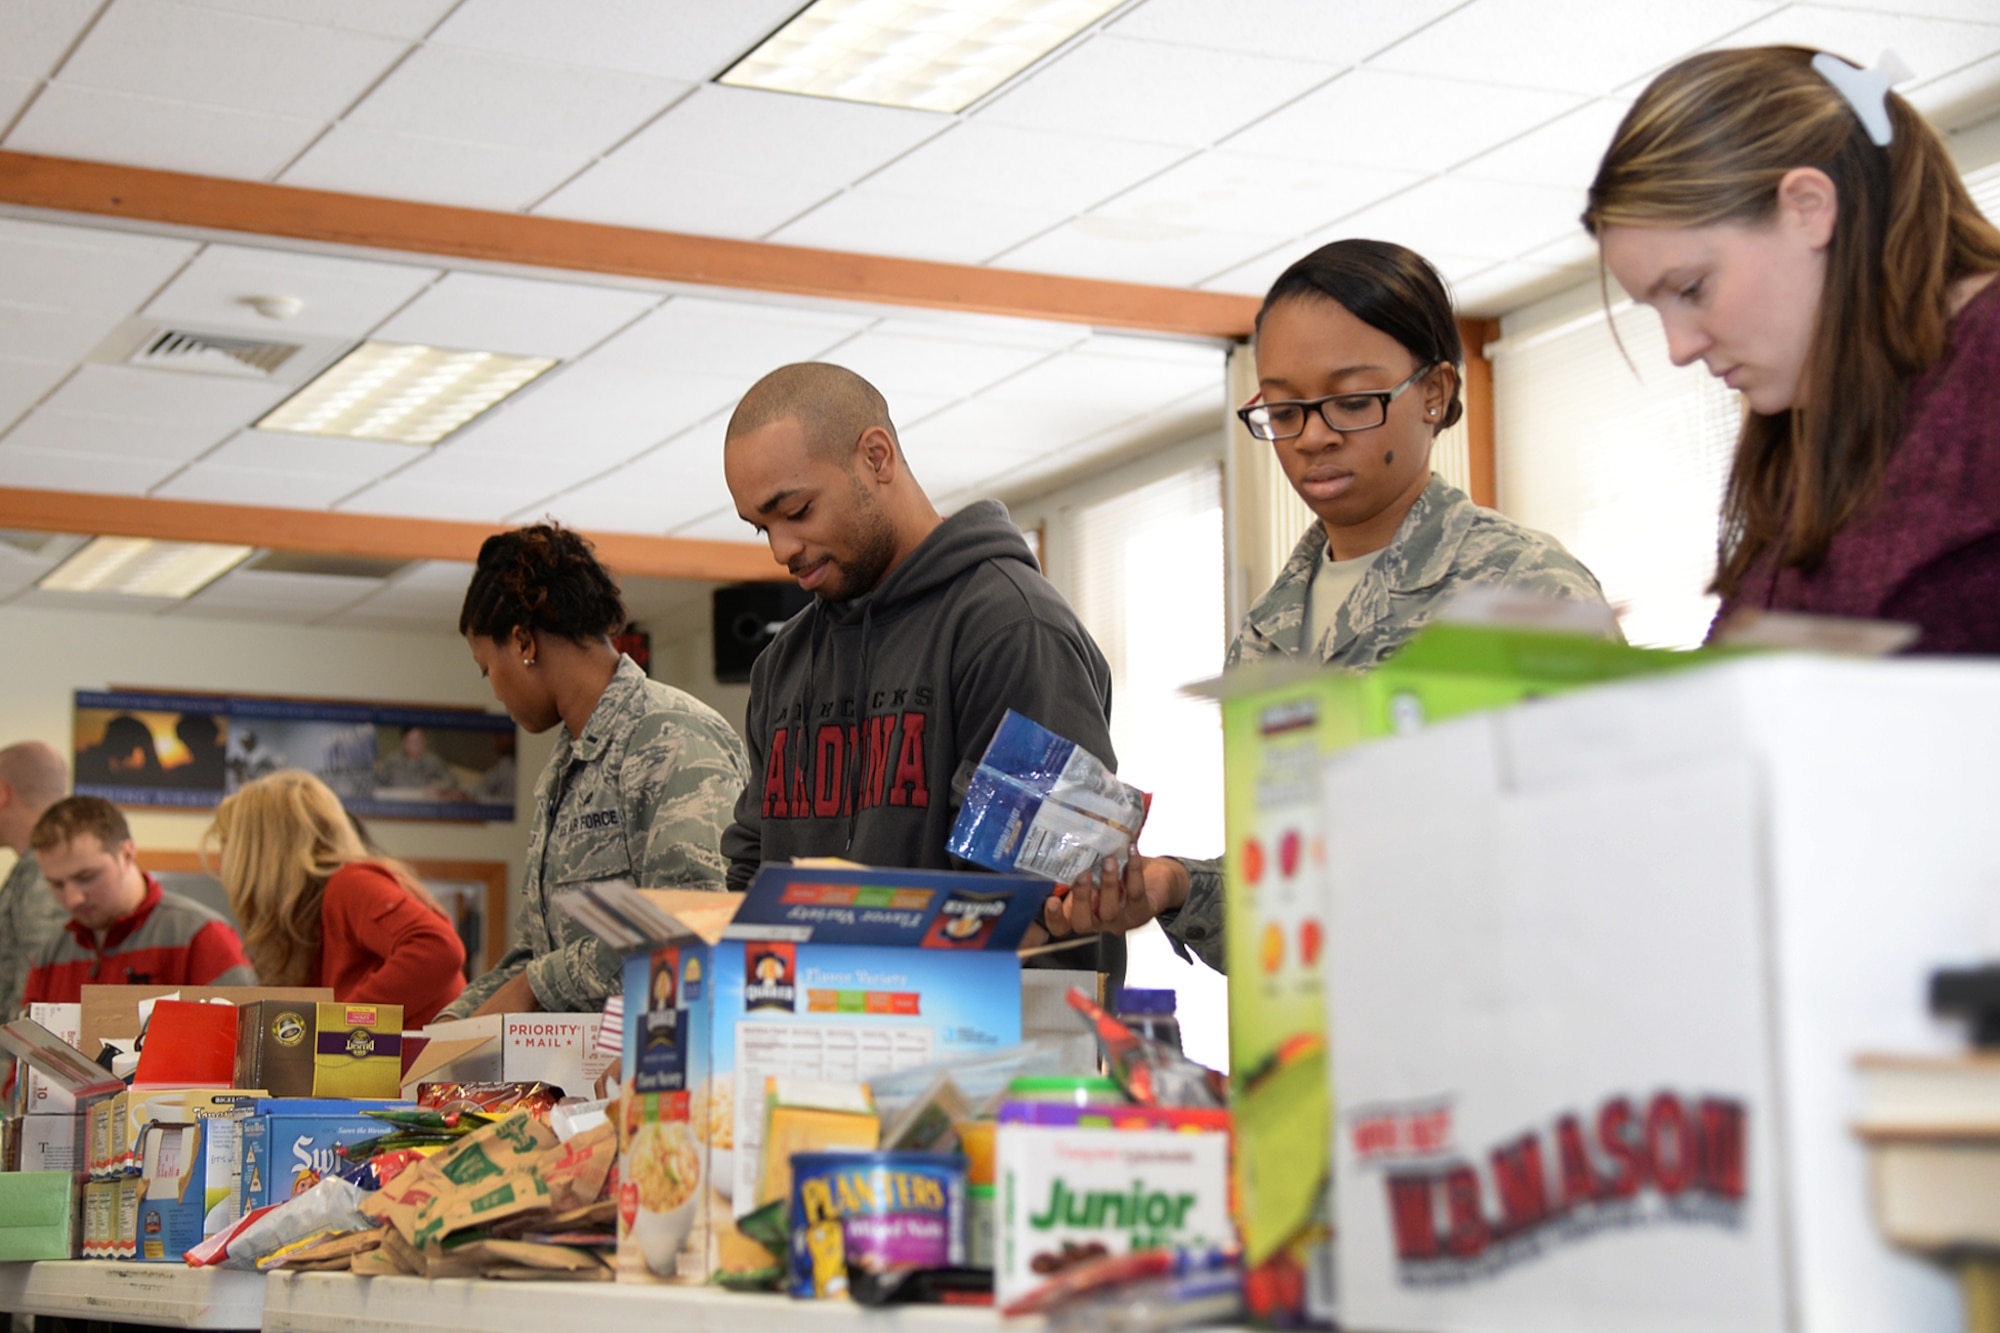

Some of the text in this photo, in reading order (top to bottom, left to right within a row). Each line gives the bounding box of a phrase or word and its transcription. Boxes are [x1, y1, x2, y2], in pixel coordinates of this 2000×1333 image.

[580, 809, 620, 830] FORCE
[786, 905, 923, 928] Flavor Variety
[745, 986, 795, 1001] QUAKER
[509, 1024, 577, 1036] PRIORITY
[525, 1038, 561, 1047] MAIL
[37, 1086, 48, 1100] 10
[802, 1172, 945, 1224] PLANTERS
[1030, 1176, 1195, 1231] Junior
[905, 1219, 943, 1238] Nuts
